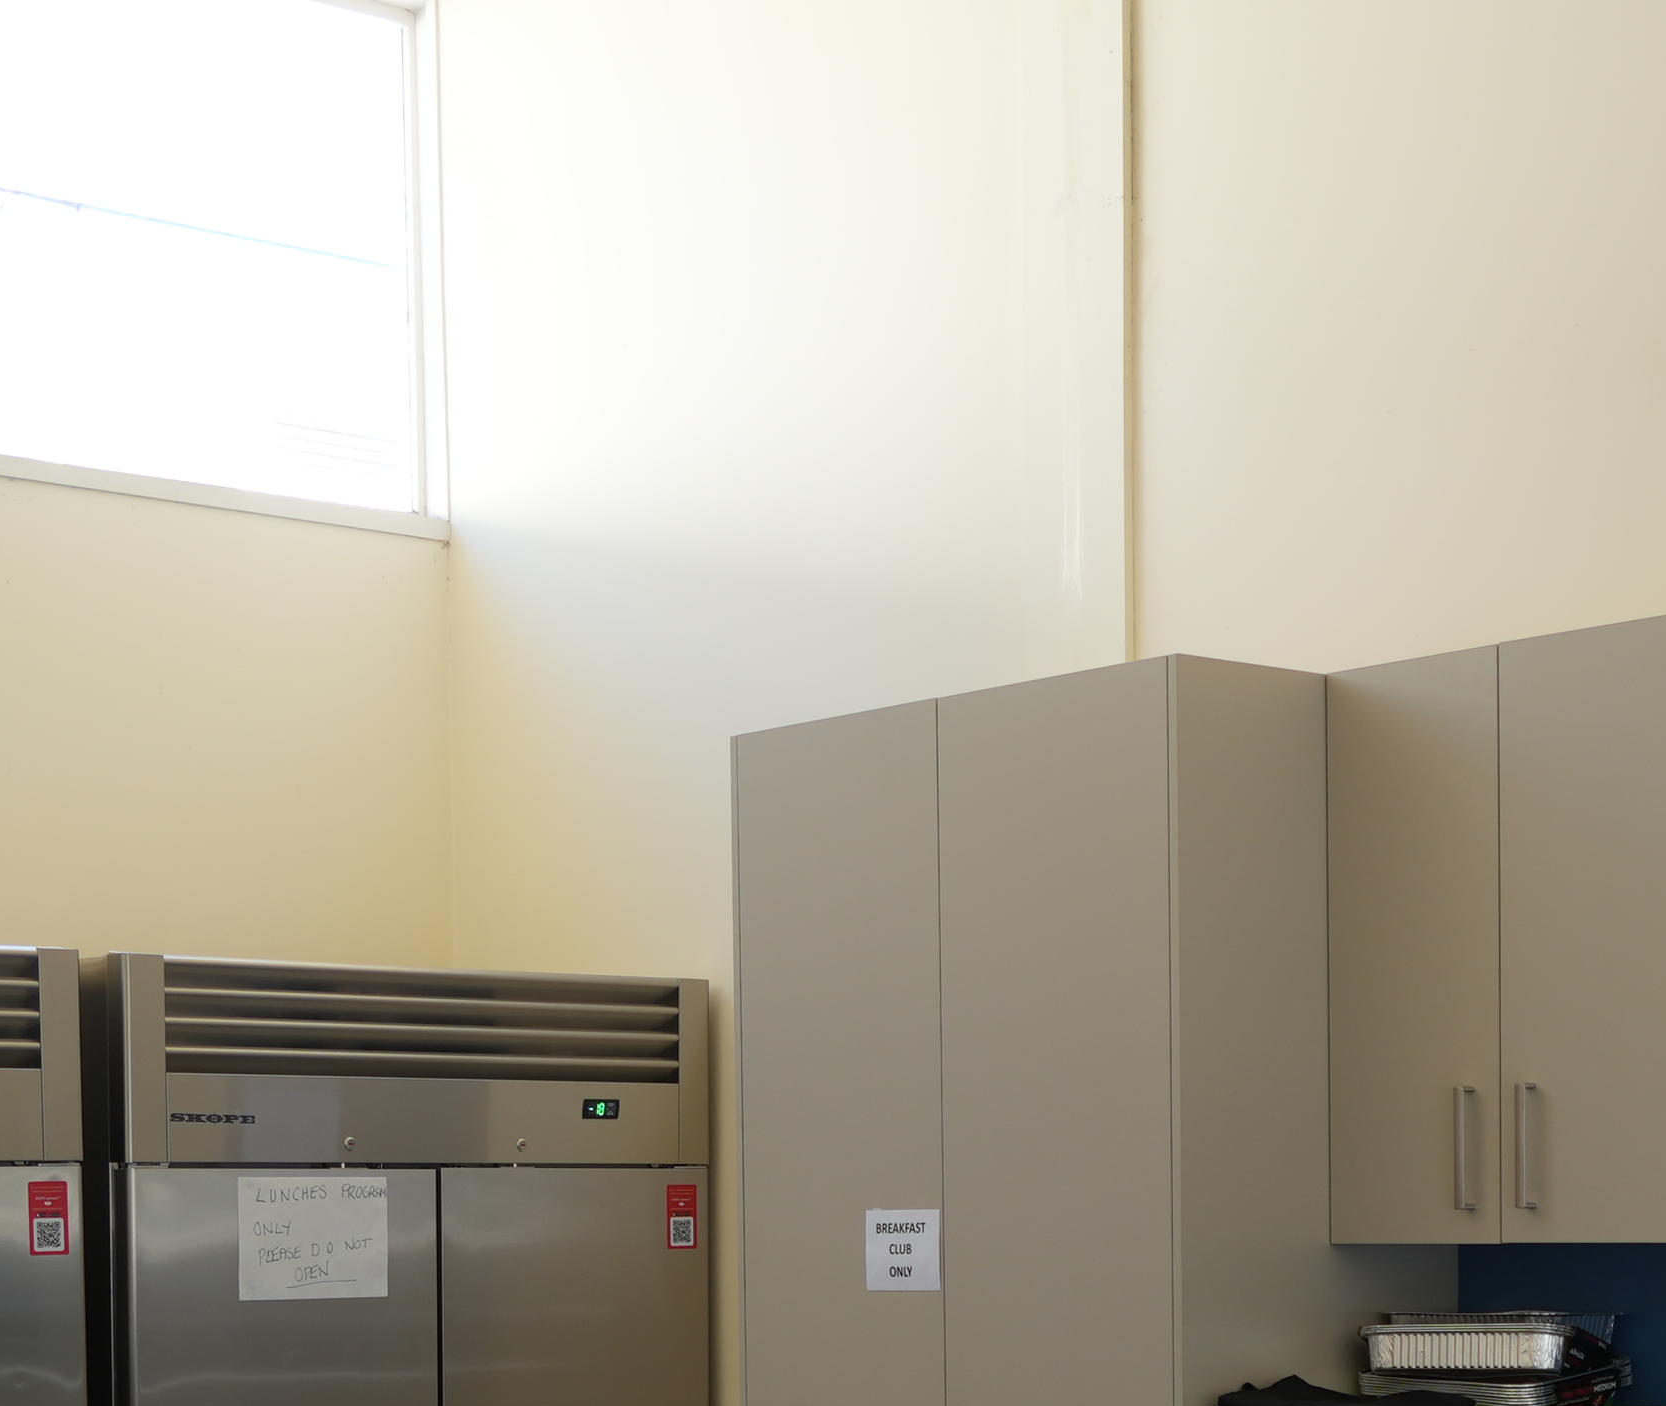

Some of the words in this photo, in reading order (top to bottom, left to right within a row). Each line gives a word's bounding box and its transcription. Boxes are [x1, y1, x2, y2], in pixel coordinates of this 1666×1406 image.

[169, 1112, 255, 1124] SKOPE
[255, 1185, 327, 1203] LUNCHES
[341, 1183, 387, 1200] PROGRAM
[253, 1221, 291, 1236] ONLY
[876, 1222, 926, 1234] BREAKFAST
[258, 1246, 301, 1266] PLEASE
[344, 1238, 373, 1251] NOT
[889, 1244, 912, 1254] CLUB
[294, 1260, 329, 1282] OPEN
[889, 1266, 913, 1278] ONLY
[1594, 1382, 1616, 1392] MEDIUM
